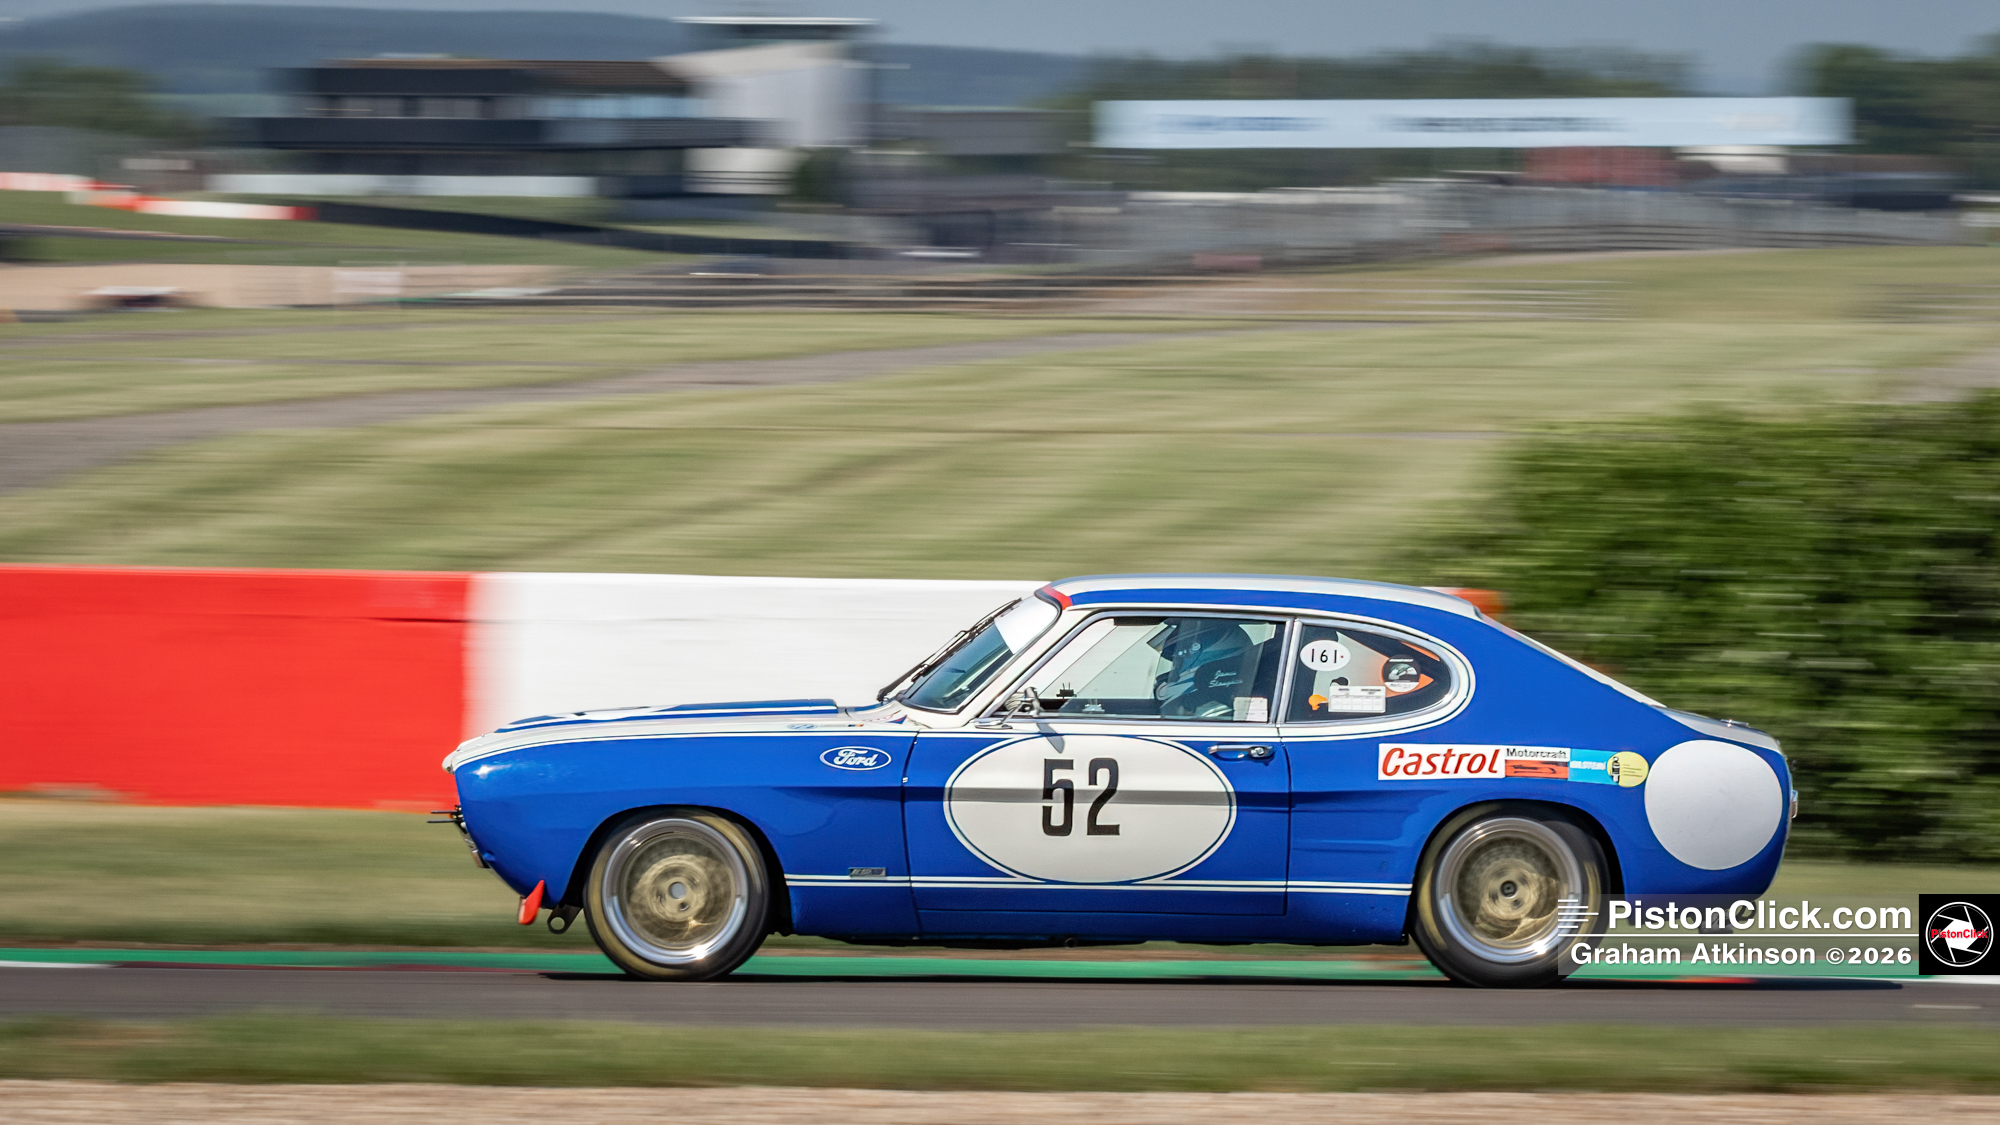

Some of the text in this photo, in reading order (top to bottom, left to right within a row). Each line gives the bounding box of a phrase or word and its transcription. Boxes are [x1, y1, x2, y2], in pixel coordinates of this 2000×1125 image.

[1311, 648, 1338, 664] 161
[833, 748, 879, 767] Ford
[1382, 747, 1501, 776] Castrol
[1506, 748, 1568, 759] Motorcraft
[1042, 757, 1120, 836] 52
